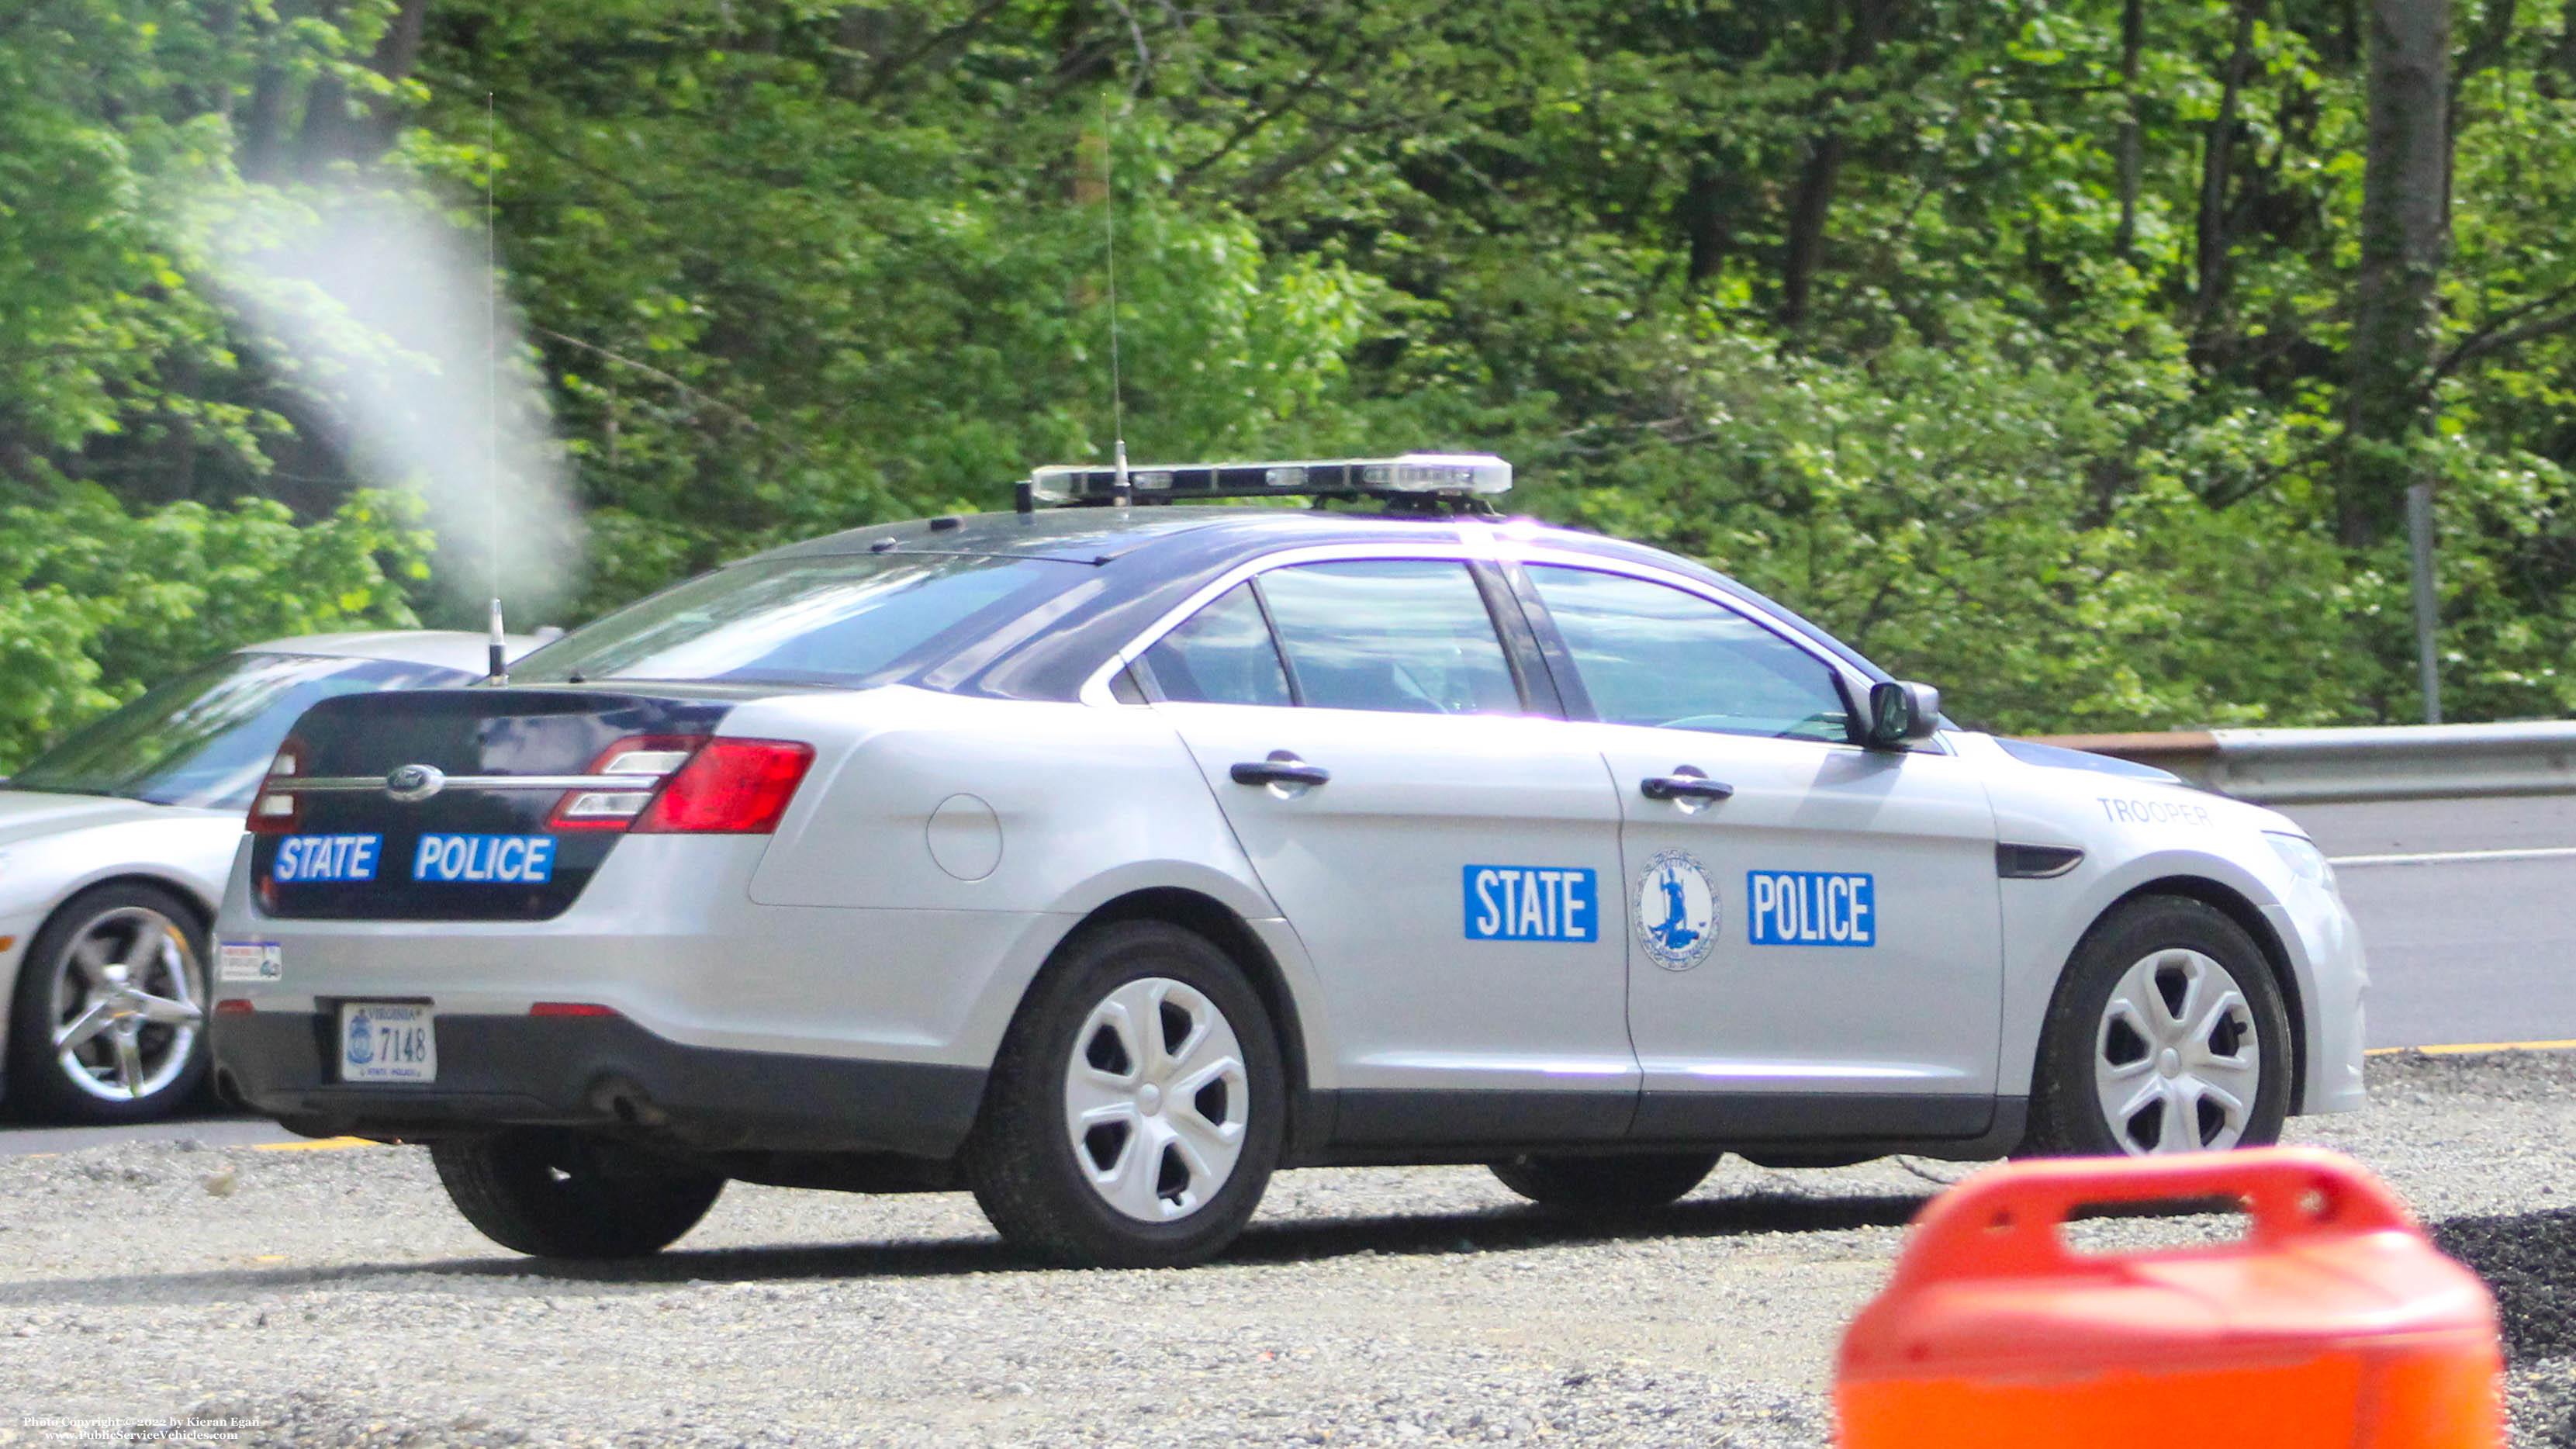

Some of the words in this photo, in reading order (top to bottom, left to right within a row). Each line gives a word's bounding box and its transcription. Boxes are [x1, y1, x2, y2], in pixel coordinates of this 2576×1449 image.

[2097, 797, 2213, 827] TROOPER
[277, 835, 377, 880] STATE
[414, 835, 552, 881] POLICE
[1476, 870, 1586, 937] STATE
[1754, 874, 1869, 941] POLICE
[368, 1008, 416, 1021] VIRGINIA
[381, 1027, 426, 1063] 7148
